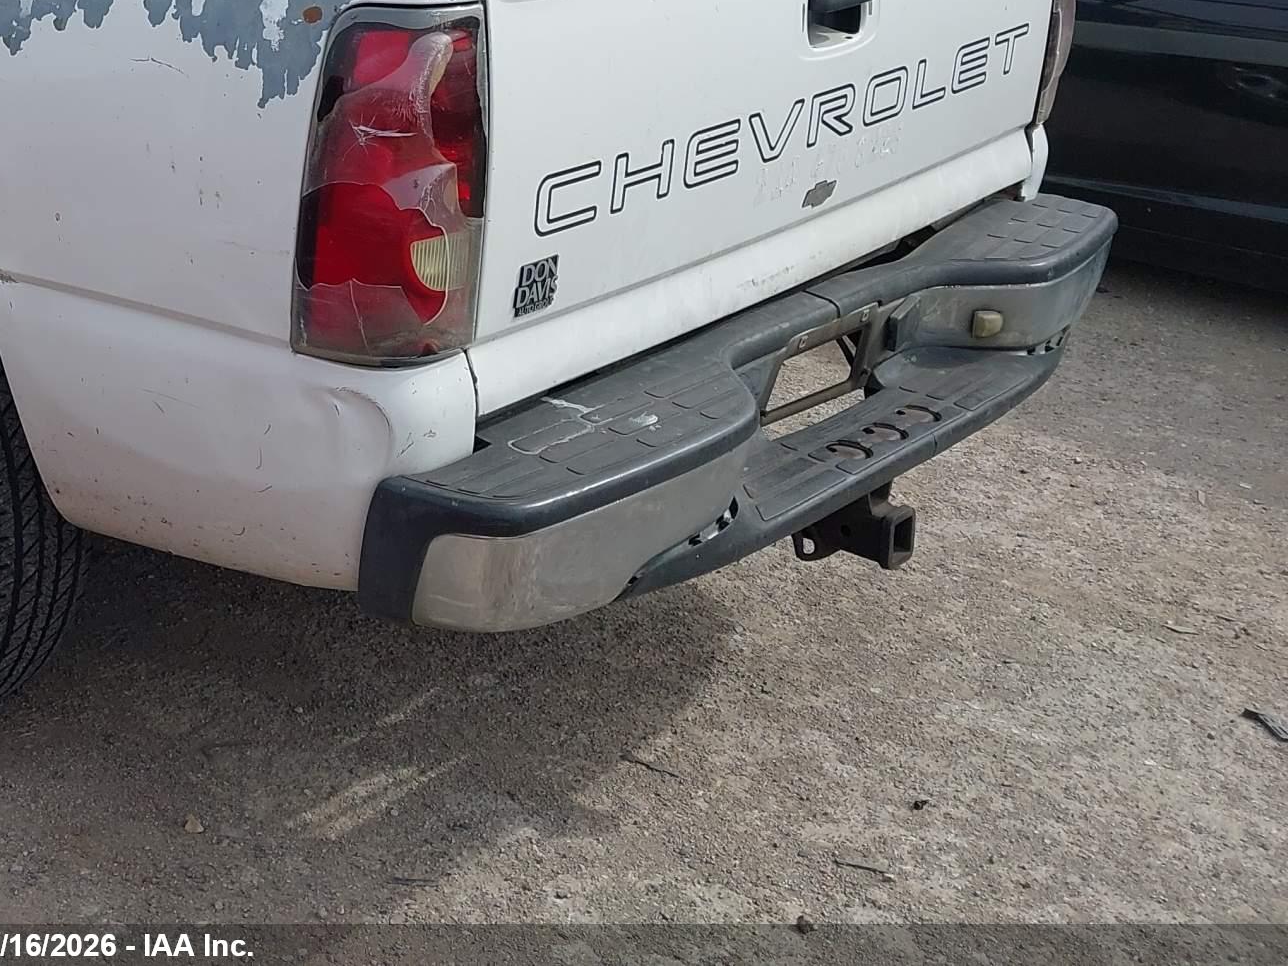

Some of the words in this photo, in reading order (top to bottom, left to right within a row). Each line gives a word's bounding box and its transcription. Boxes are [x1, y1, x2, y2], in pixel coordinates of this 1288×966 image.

[534, 23, 1030, 237] CHEVROLET
[522, 257, 558, 287] DON
[515, 275, 558, 309] DAVIS
